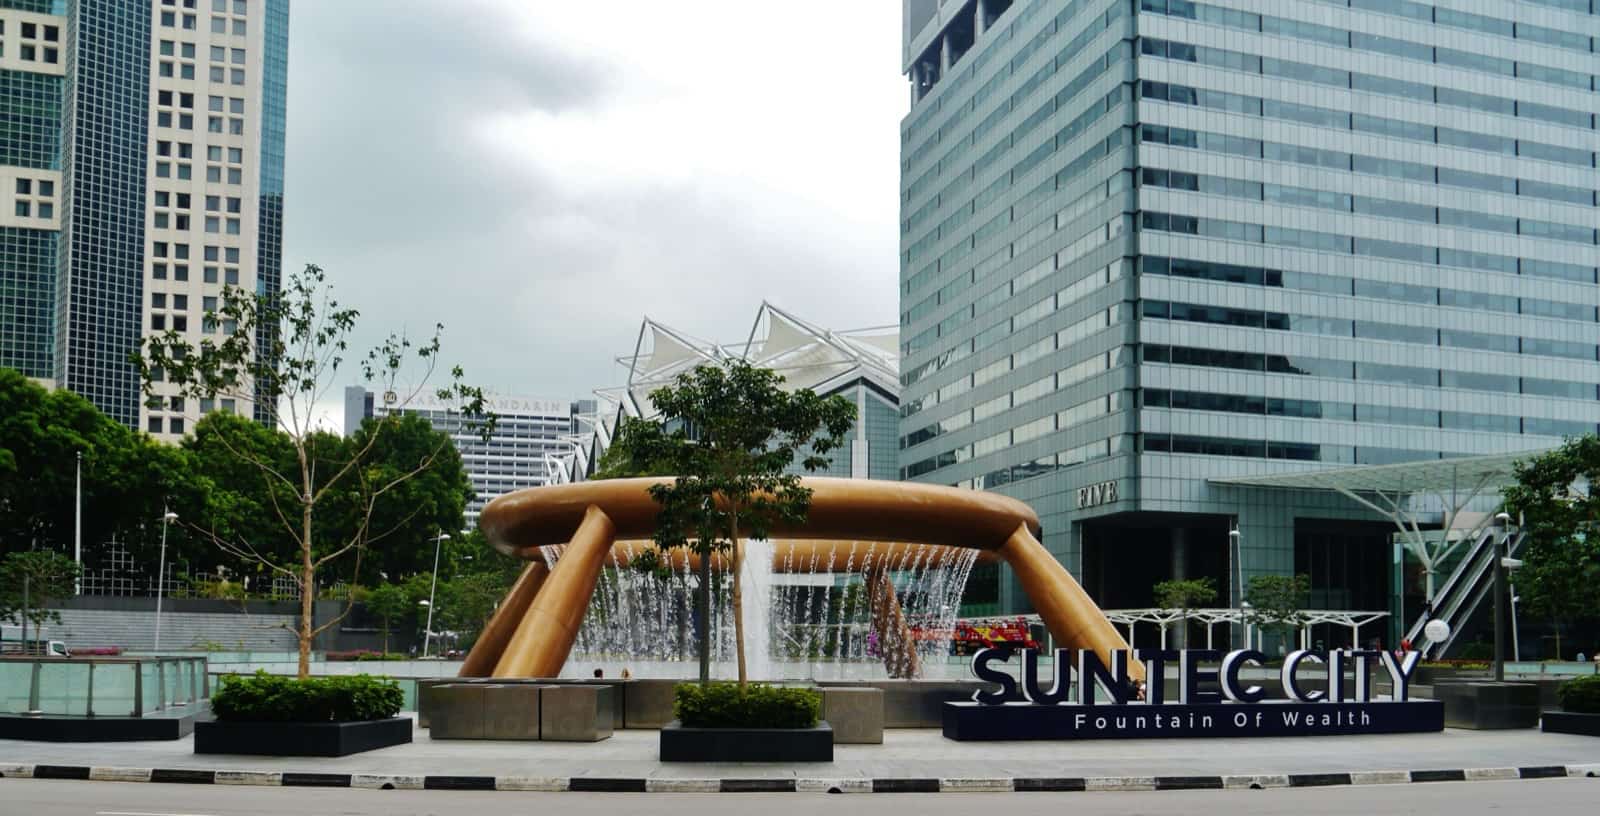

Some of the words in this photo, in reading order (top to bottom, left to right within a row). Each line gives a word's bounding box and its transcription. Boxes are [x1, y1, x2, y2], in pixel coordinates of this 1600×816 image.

[476, 398, 561, 412] ANDARIN
[1077, 480, 1118, 509] FIVE
[971, 648, 1265, 704] SUNTEC
[1281, 649, 1420, 704] CITY
[1074, 713, 1213, 729] Fountain
[1234, 712, 1264, 727] Of
[1283, 711, 1371, 727] Wealth
